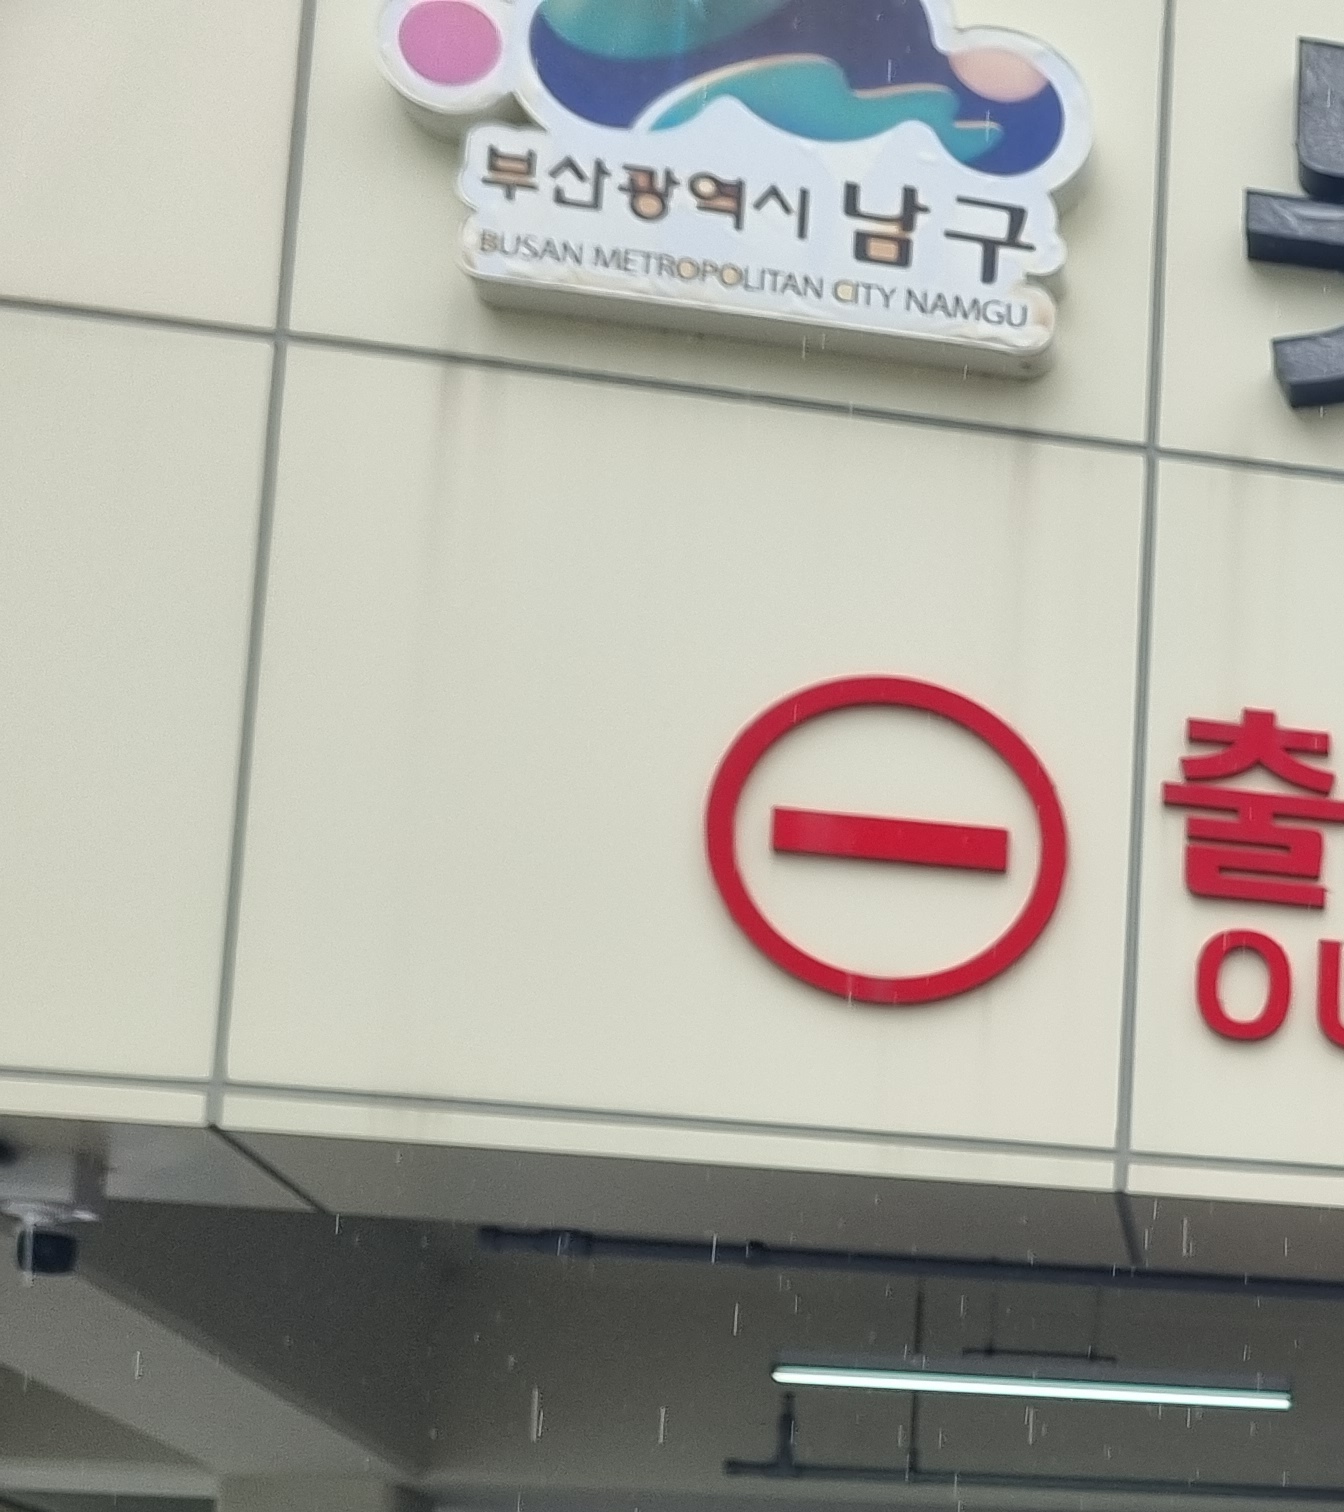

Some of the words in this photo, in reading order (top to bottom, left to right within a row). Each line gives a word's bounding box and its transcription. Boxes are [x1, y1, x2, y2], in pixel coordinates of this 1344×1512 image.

[482, 144, 811, 240] 부산광역시
[844, 181, 1036, 285] 남구
[480, 228, 583, 266] BUSAN
[592, 246, 825, 300] METROPOLITAN
[833, 277, 896, 308] CITY
[905, 288, 1028, 328] NAMGU
